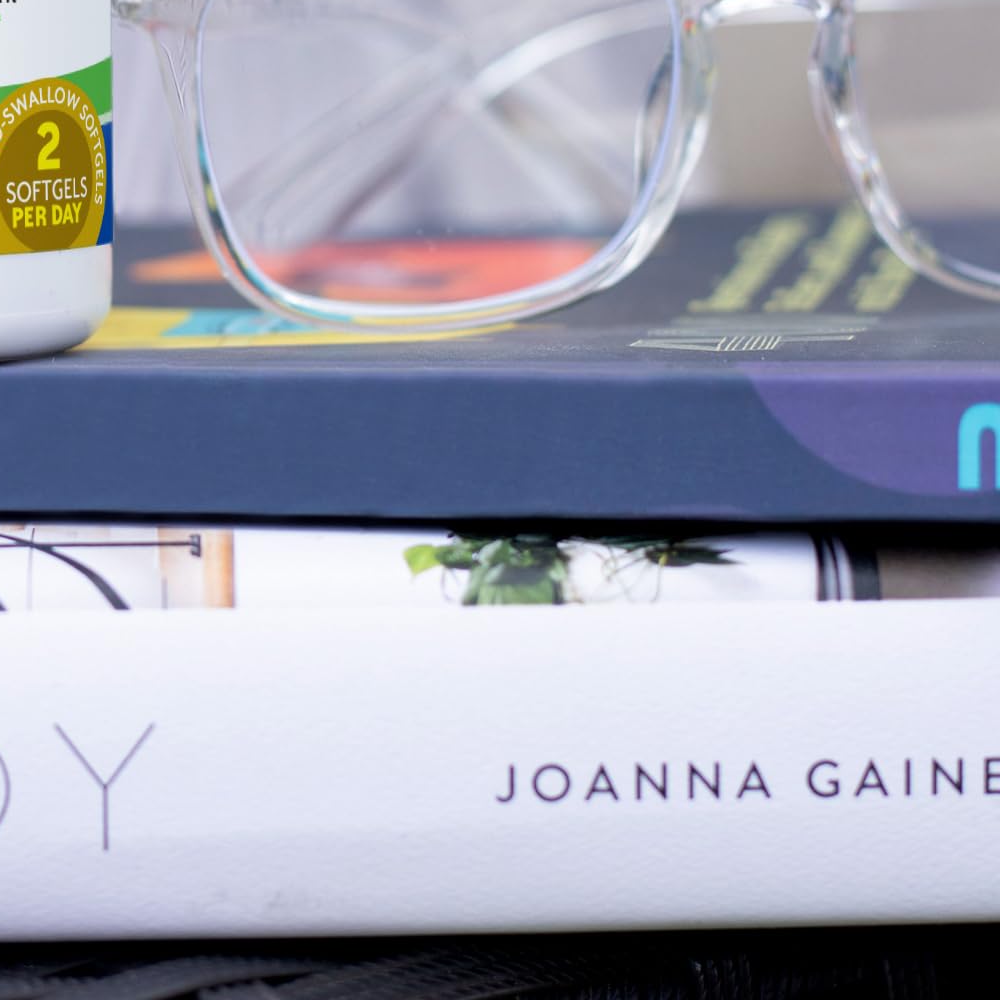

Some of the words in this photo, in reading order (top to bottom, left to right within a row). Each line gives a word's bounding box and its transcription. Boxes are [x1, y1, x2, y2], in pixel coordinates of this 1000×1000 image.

[36, 121, 61, 171] 2
[79, 104, 105, 206] SOFTGELS
[6, 176, 88, 205] SOFTGELS
[12, 205, 47, 229] PER
[52, 201, 83, 226] DAY
[496, 761, 772, 803] JOANNA
